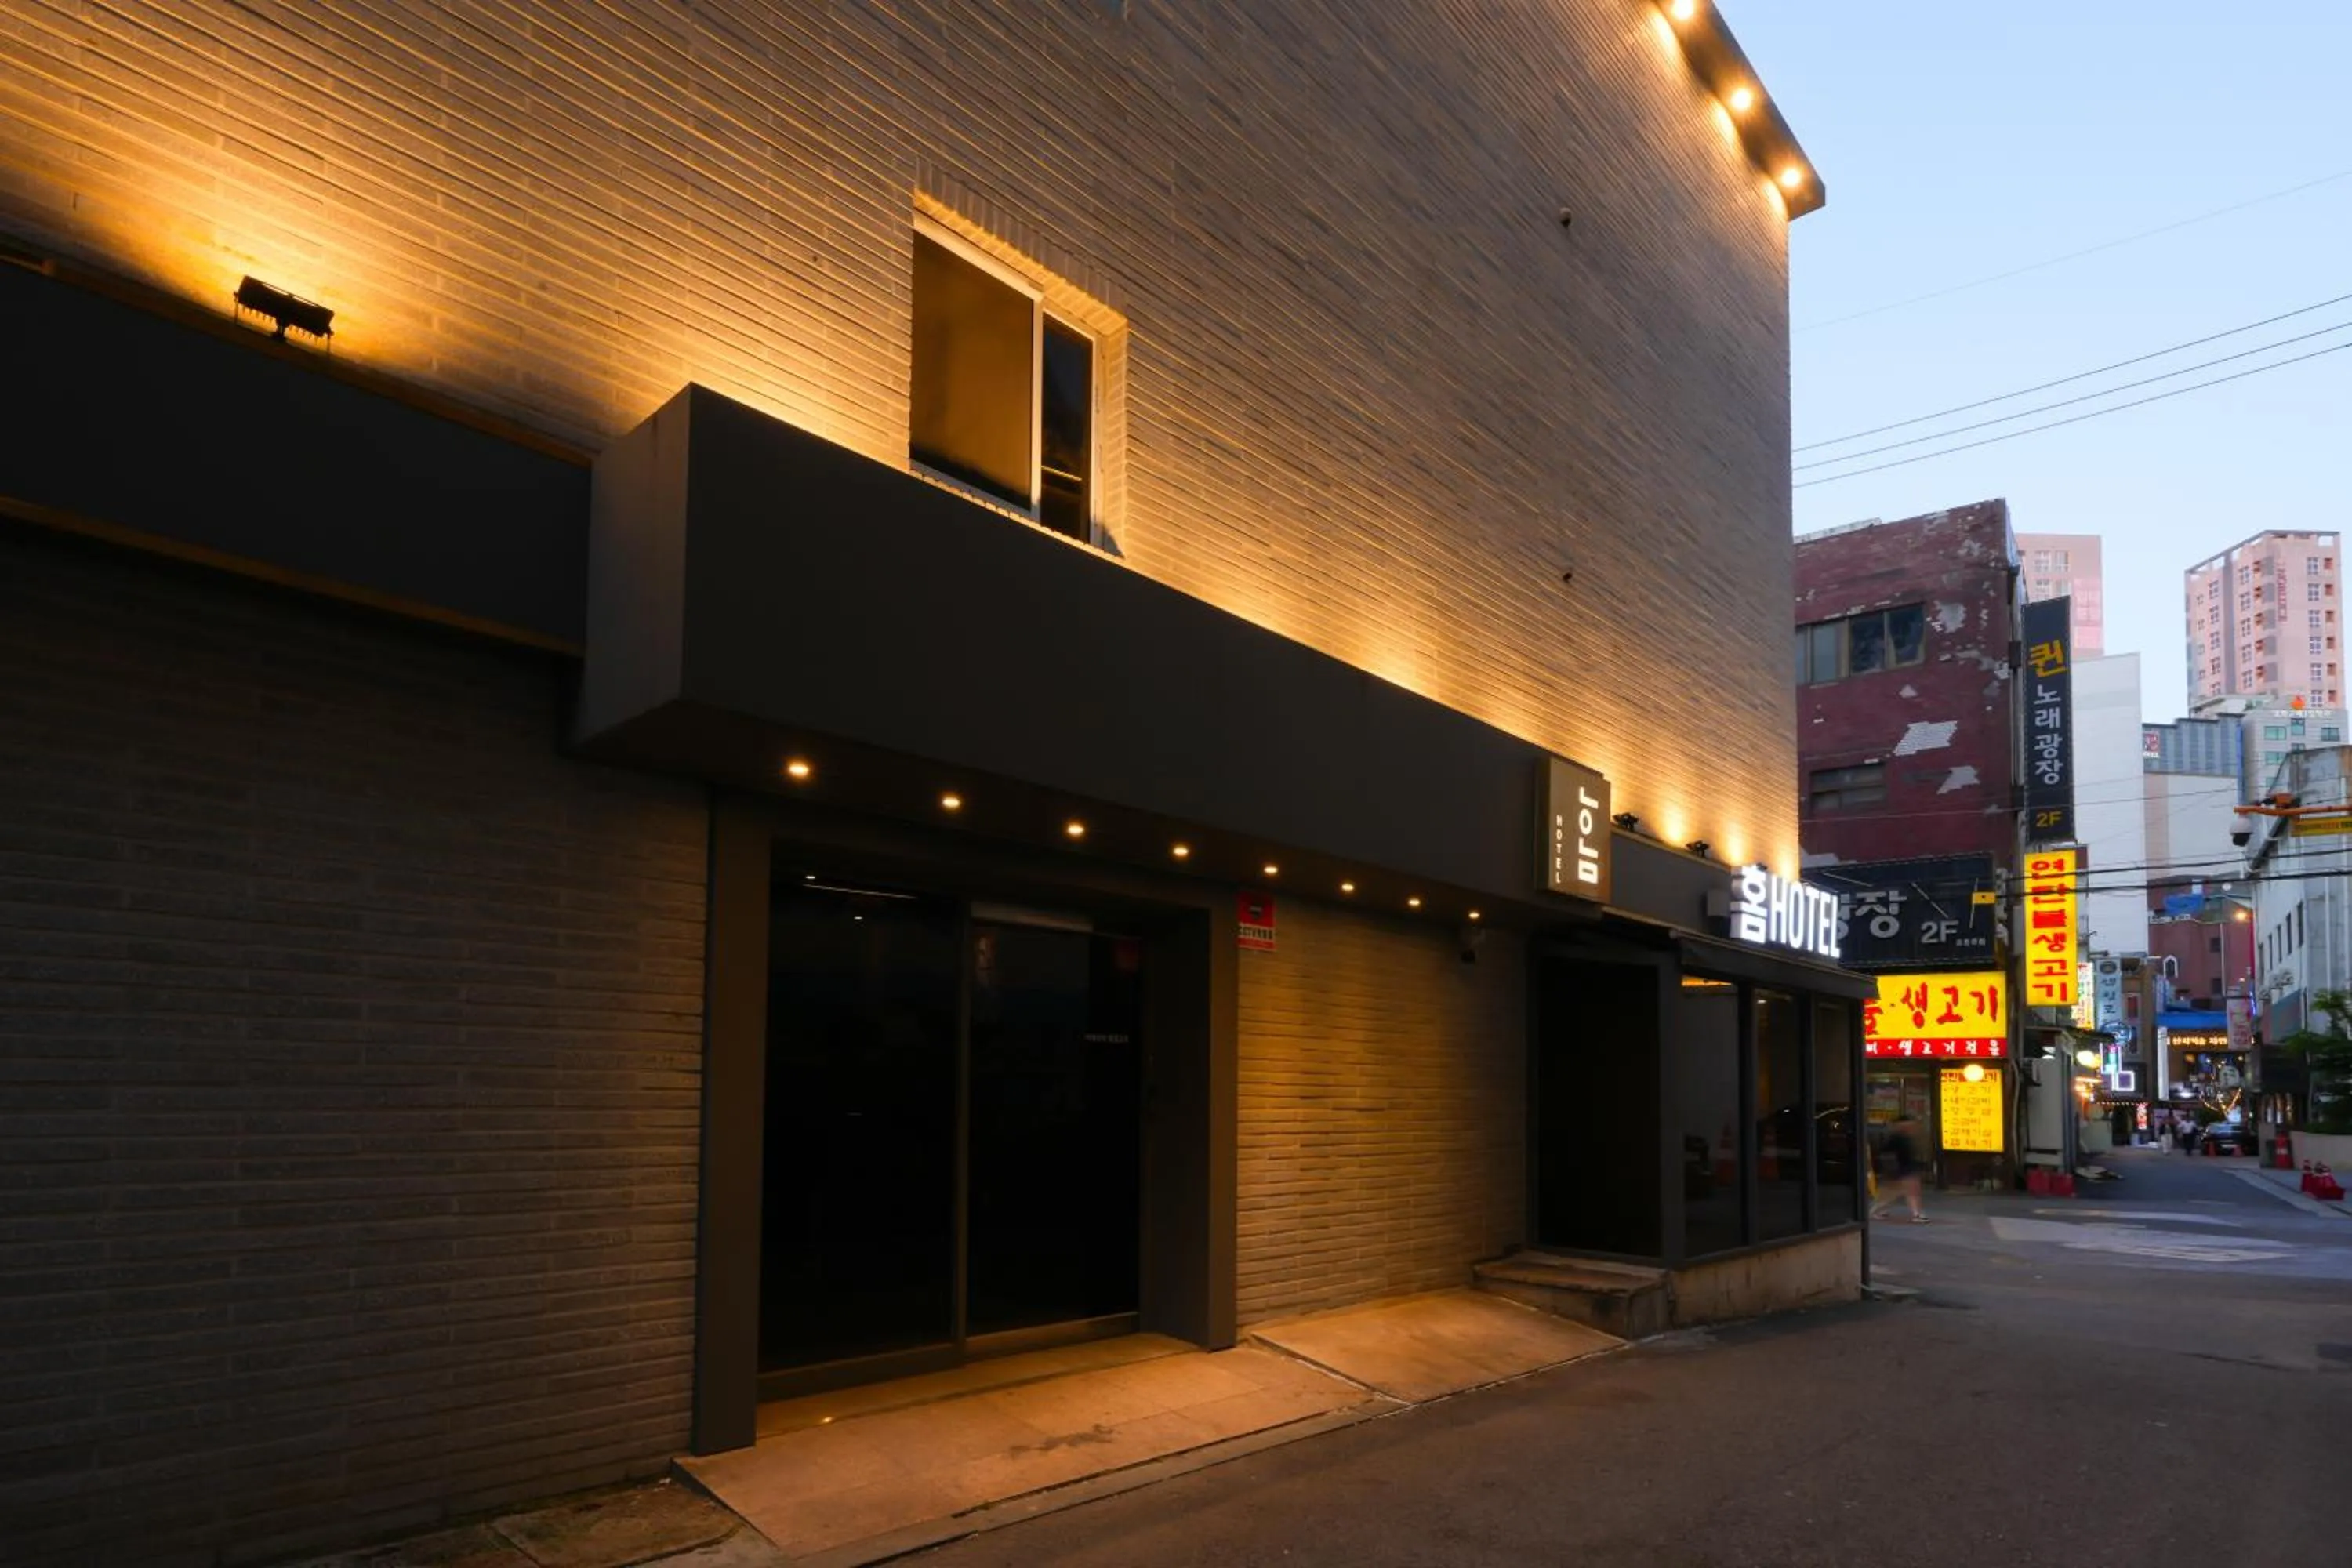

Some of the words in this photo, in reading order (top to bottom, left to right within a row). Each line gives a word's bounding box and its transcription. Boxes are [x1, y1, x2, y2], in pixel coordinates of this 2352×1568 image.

[2028, 639, 2067, 677] 퀸
[2034, 685, 2062, 785] 노래광장
[2036, 811, 2062, 827] 2F
[1770, 874, 1840, 959] HOTEL
[1921, 920, 1958, 944] 2F
[1900, 982, 1998, 1029] 생고기
